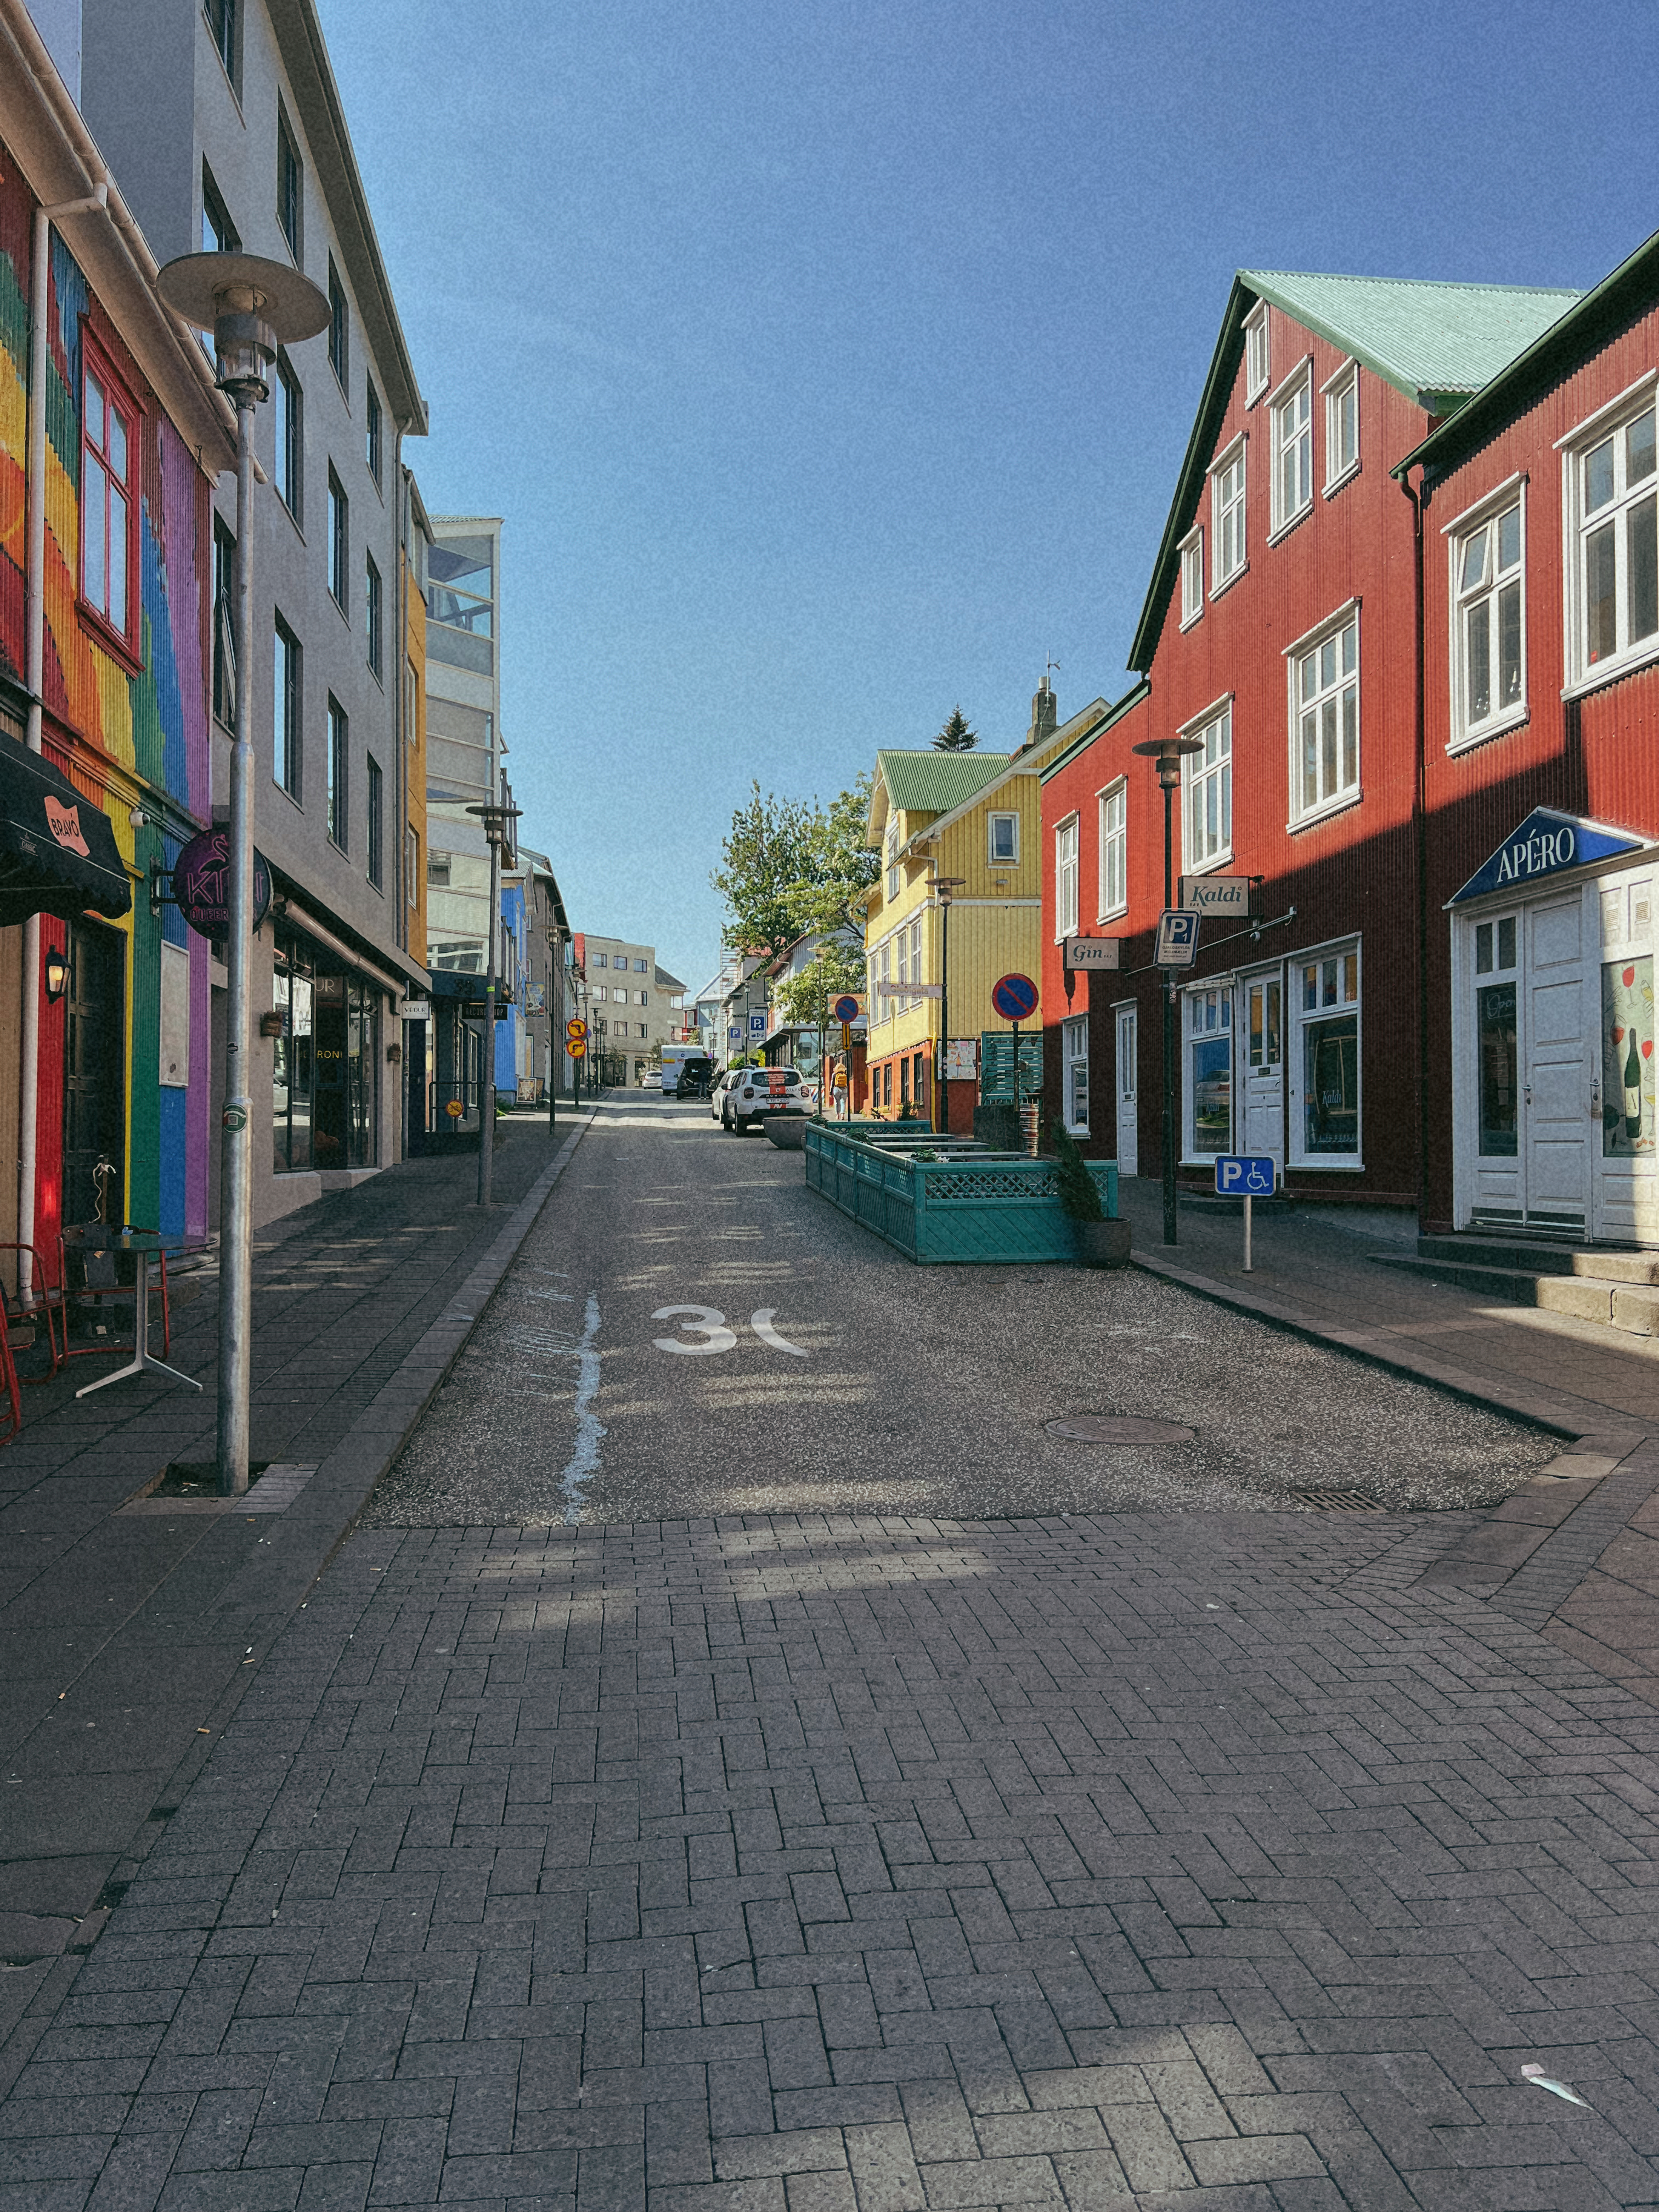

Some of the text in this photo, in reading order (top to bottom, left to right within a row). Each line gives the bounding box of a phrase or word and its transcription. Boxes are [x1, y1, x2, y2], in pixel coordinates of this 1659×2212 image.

[50, 813, 79, 837] BRAVÓ
[1497, 827, 1575, 883] APÉRO
[1190, 886, 1242, 906] Kaldi
[190, 908, 229, 922] QUEER
[1073, 945, 1103, 962] Gin
[1322, 1090, 1341, 1108] Kaldi
[1223, 1161, 1242, 1189] P
